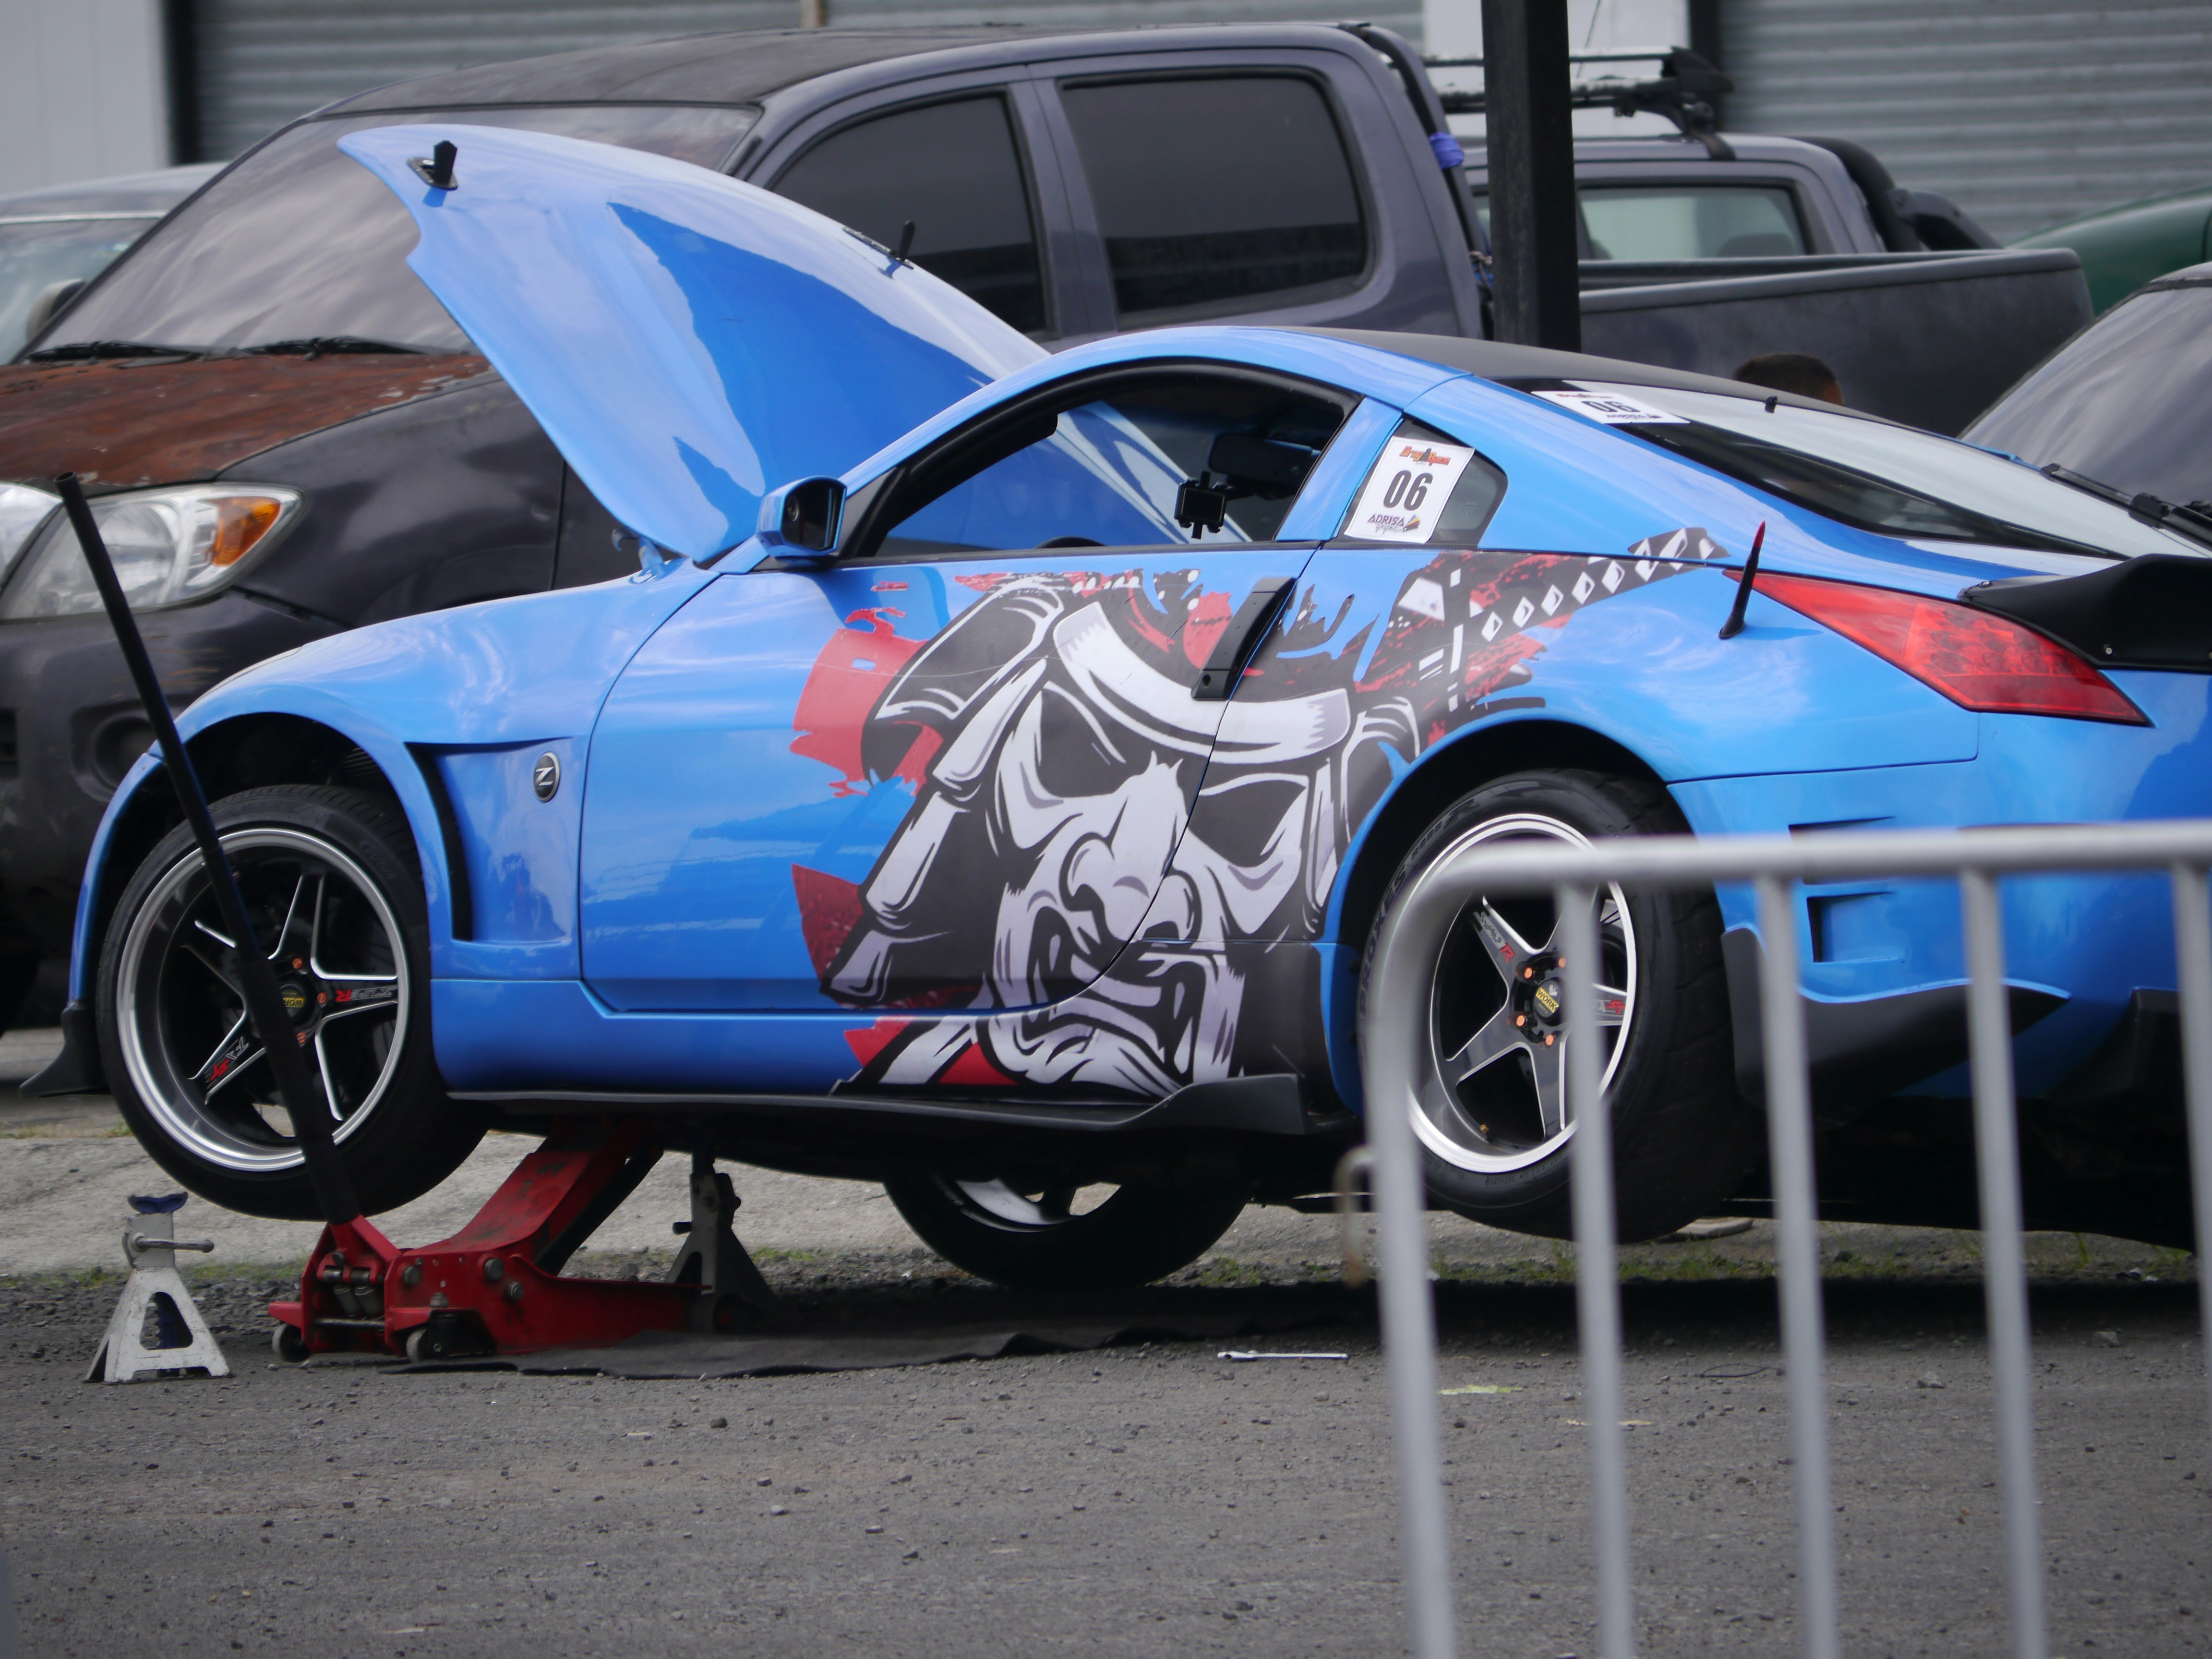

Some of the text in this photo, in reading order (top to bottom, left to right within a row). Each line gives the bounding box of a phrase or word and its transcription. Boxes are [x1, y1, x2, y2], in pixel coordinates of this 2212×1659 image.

[1581, 400, 1641, 413] 06
[1383, 469, 1433, 511] 06
[1367, 513, 1405, 527] ADRISA
[535, 766, 555, 787] Z
[282, 999, 302, 1007] WOR
[1538, 989, 1558, 1011] WORK
